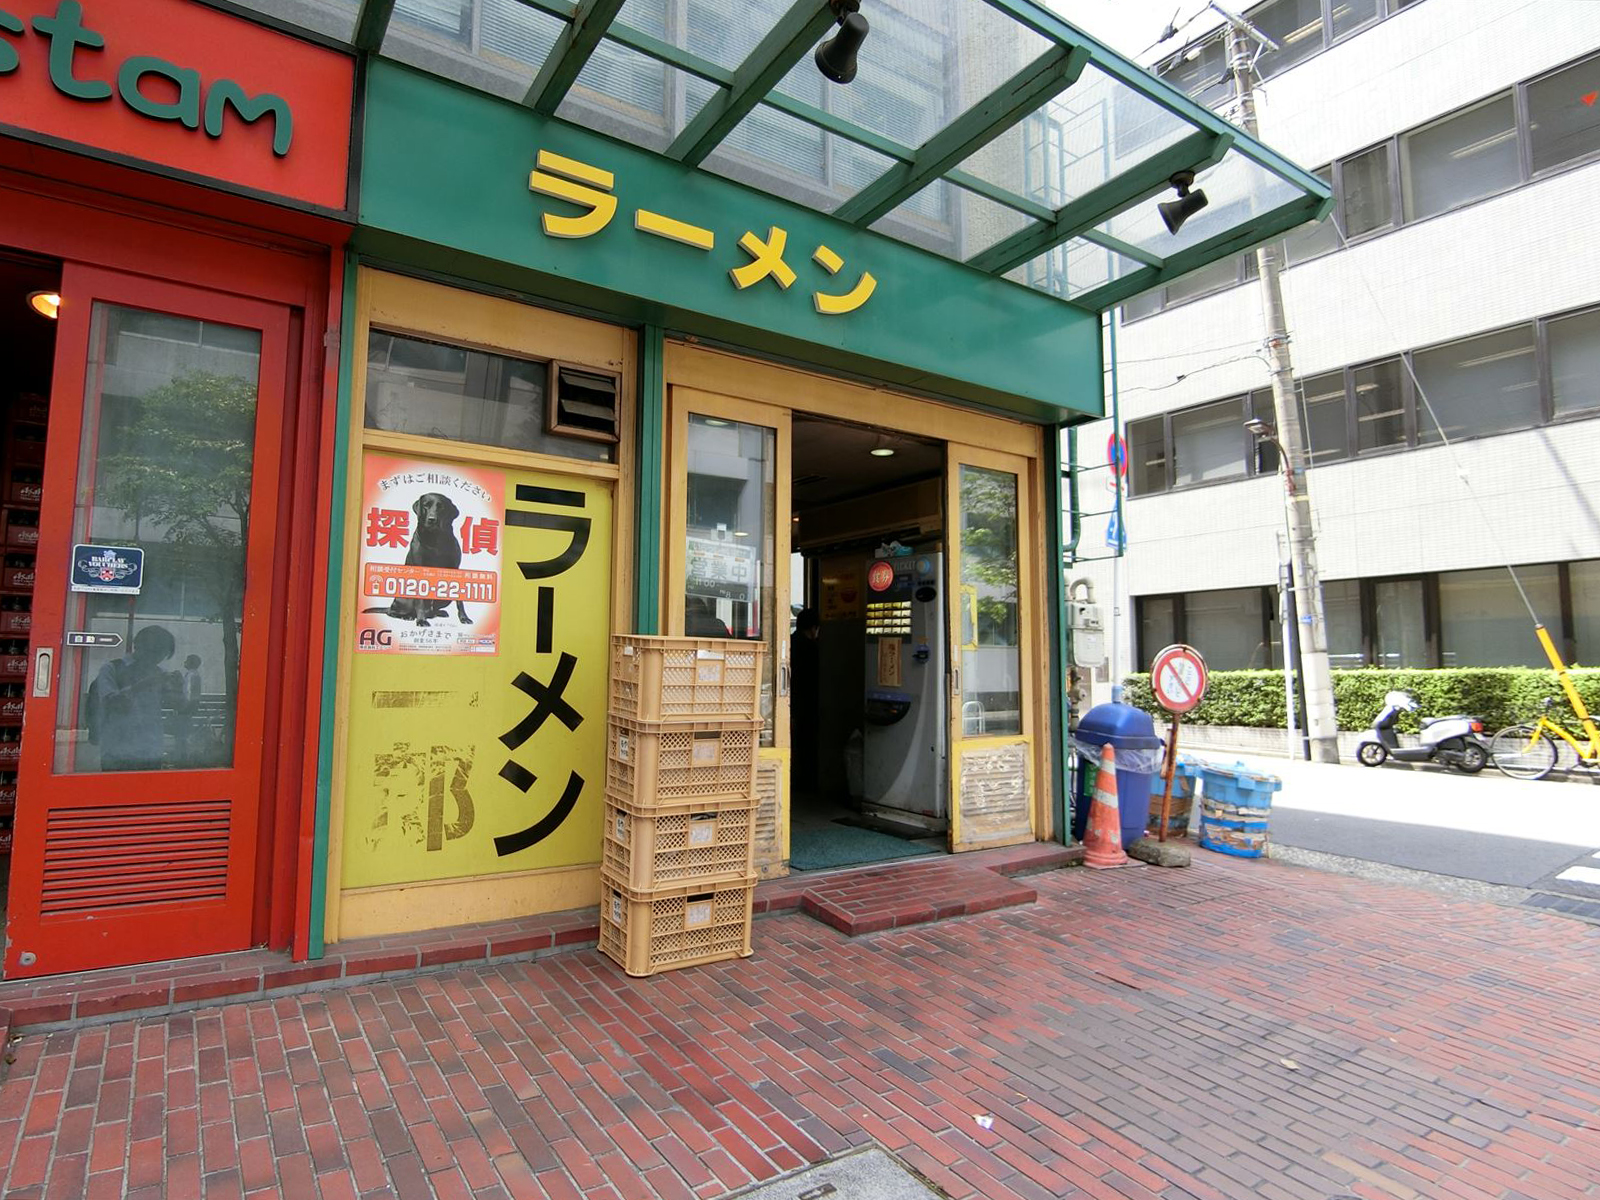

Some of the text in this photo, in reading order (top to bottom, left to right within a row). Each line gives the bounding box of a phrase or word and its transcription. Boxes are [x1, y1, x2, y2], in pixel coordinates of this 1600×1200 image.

[529, 149, 877, 315] ラーメン
[379, 472, 491, 502] まずはご相談ください
[690, 556, 747, 582] 営業中
[385, 577, 493, 600] 0120-22-1111
[359, 628, 393, 646] AG
[400, 629, 452, 640] おかげさまで
[493, 484, 592, 857] ラーメン
